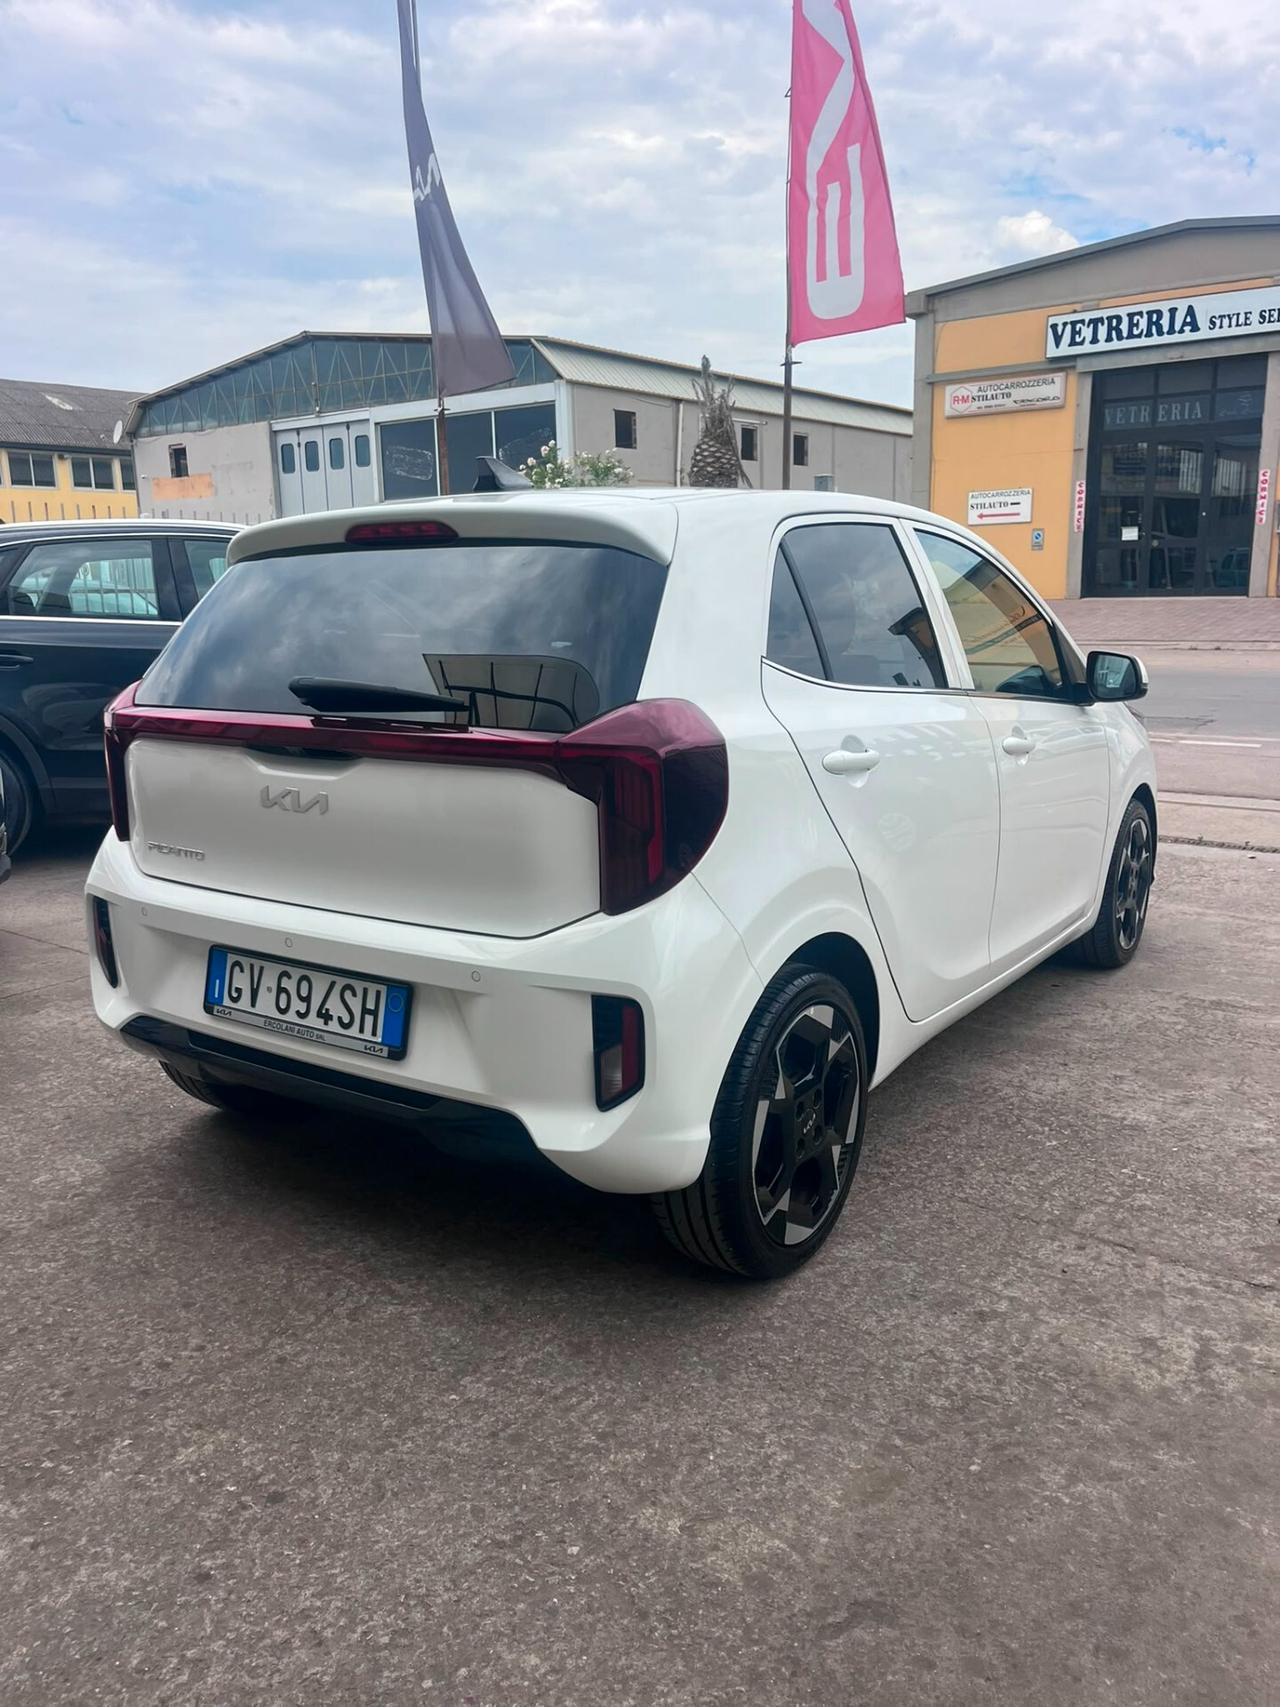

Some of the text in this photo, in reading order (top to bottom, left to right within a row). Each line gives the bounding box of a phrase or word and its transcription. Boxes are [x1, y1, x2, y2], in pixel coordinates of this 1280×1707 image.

[1049, 304, 1201, 349] VETRERIA
[1208, 311, 1253, 331] STYLE
[976, 377, 1056, 393] AUTOCARROZZERIA
[971, 391, 1012, 403] STILAUTO
[1104, 400, 1202, 425] VETRERIA
[970, 489, 1031, 499] AUTOCARROZZERIA
[970, 501, 1009, 510] STILAUTO
[260, 784, 330, 816] KIA
[147, 841, 206, 861] PICANTO
[263, 1019, 296, 1034] ERCOLANI
[296, 1027, 315, 1039] AUTO
